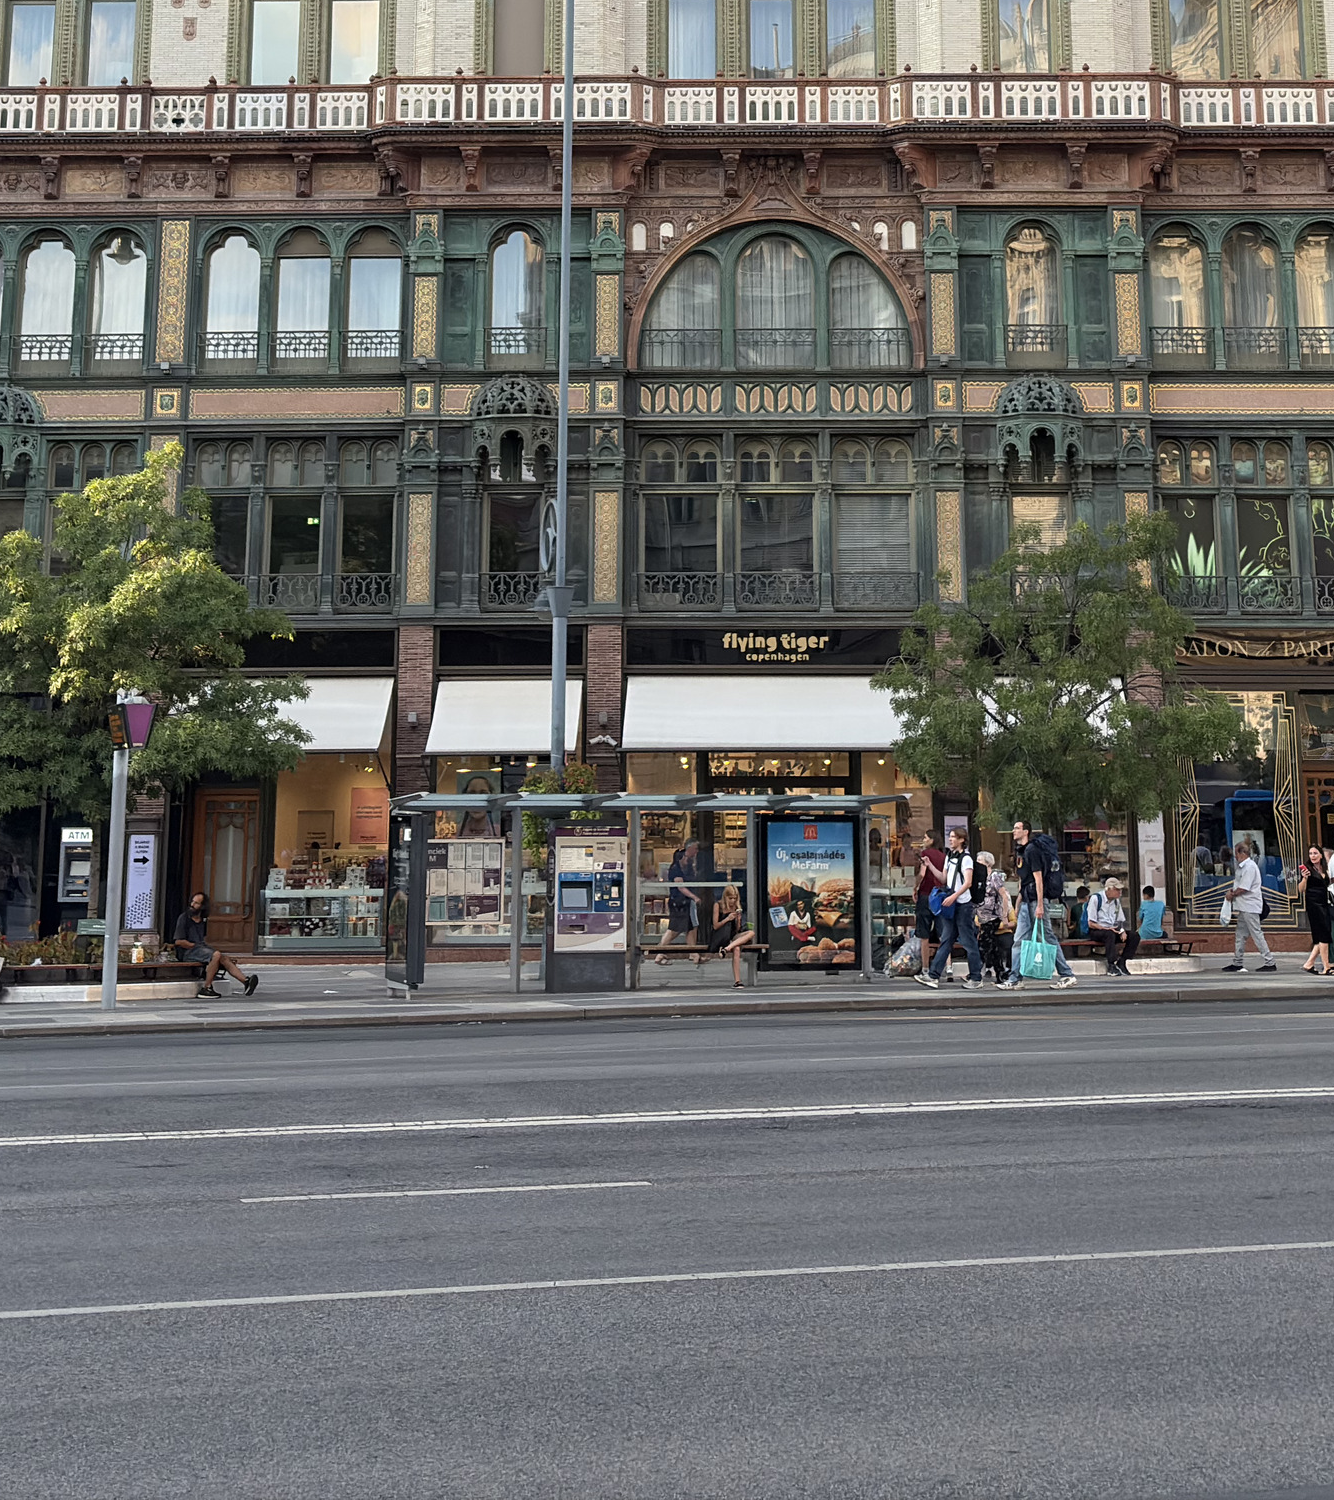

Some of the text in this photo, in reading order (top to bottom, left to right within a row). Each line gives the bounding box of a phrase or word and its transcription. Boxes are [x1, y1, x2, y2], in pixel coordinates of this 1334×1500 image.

[722, 633, 829, 652] flying tiger
[1175, 640, 1249, 657] SALON
[746, 652, 809, 663] copenhagen
[68, 831, 90, 839] ATM
